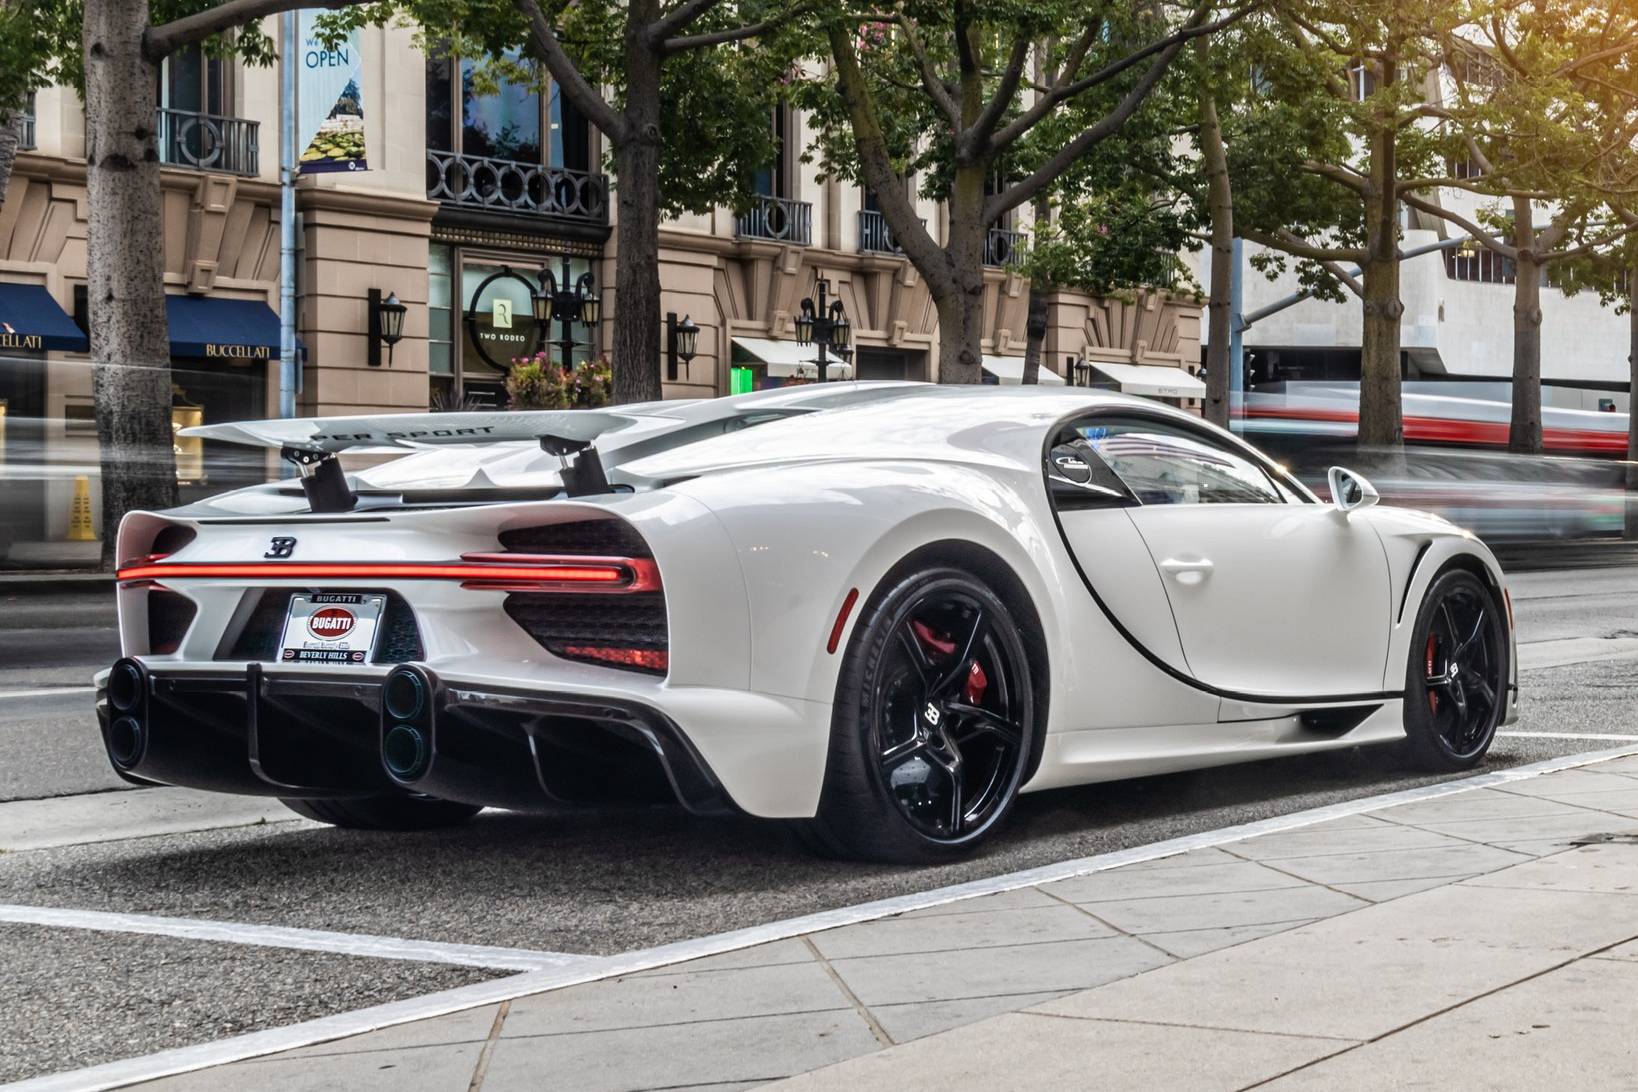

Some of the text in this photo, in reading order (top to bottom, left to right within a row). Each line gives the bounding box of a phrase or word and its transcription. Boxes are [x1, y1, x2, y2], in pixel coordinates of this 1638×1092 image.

[306, 49, 348, 68] OPEN
[0, 333, 42, 349] ELLATI
[206, 343, 271, 359] BUCCELLATI
[387, 426, 495, 439] SPORT
[316, 595, 357, 603] BUGATTI
[312, 616, 352, 630] BUGATTI
[299, 650, 328, 660] BEVERLY
[328, 652, 348, 660] HILLS
